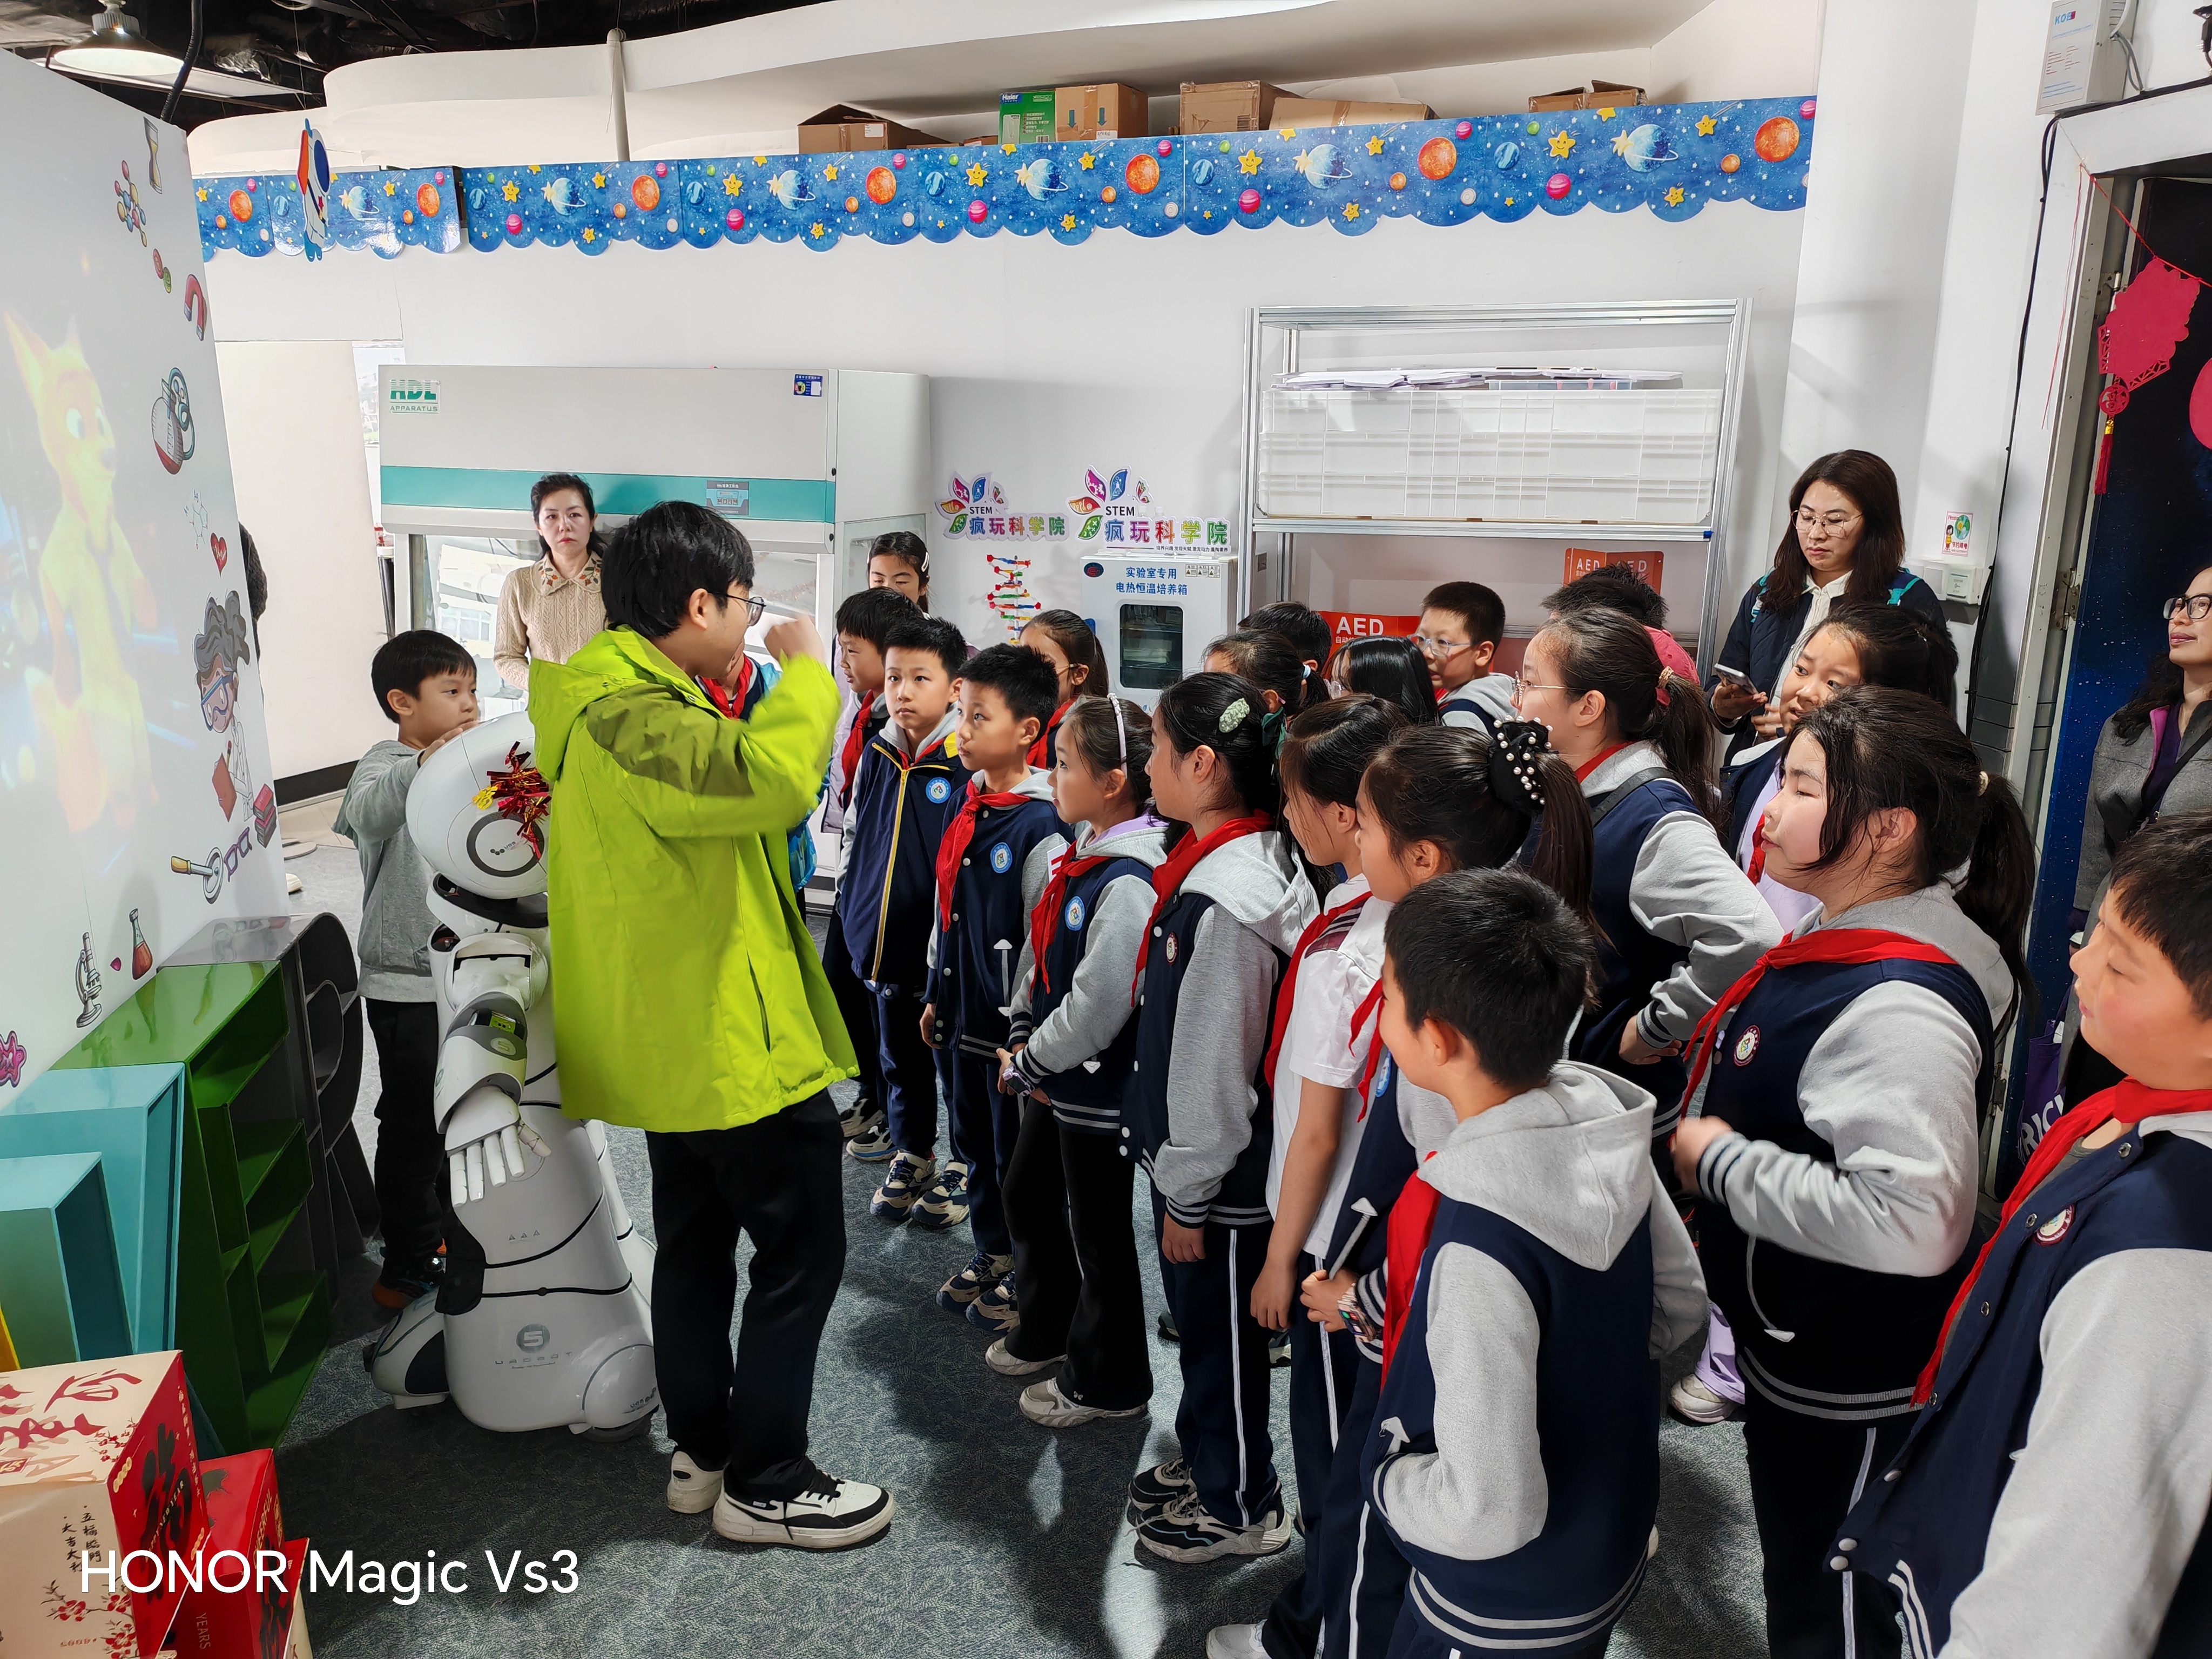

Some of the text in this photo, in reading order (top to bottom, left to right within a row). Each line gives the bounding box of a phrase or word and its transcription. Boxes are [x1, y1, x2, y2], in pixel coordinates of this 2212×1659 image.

[390, 379, 436, 400] HDL
[969, 507, 993, 515] STEM
[1105, 506, 1135, 516] STEM
[969, 516, 1065, 536] 疯玩科学院
[1104, 519, 1228, 545] 疯玩科学院
[1577, 558, 1600, 571] AED
[1126, 567, 1177, 579] 实验室专用
[1116, 582, 1188, 595] 电热恒温培养箱
[1336, 616, 1384, 636] AED
[195, 1612, 211, 1650] YEARS
